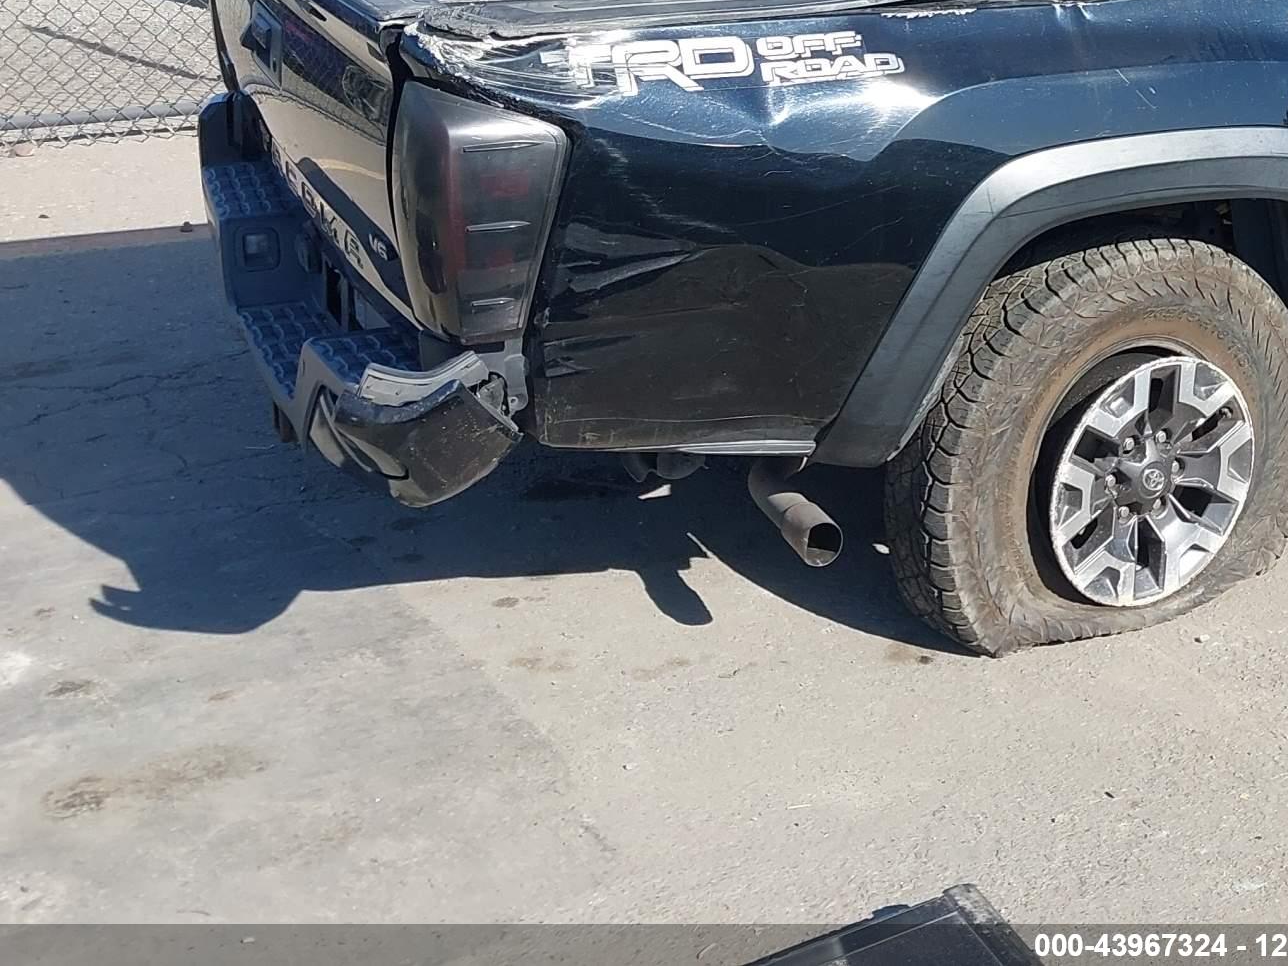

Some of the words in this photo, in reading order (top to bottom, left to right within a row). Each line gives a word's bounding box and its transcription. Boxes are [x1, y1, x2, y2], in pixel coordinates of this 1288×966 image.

[756, 31, 863, 59] OFF
[541, 35, 756, 97] TRD
[760, 52, 906, 87] ROAD
[368, 233, 389, 262] V6
